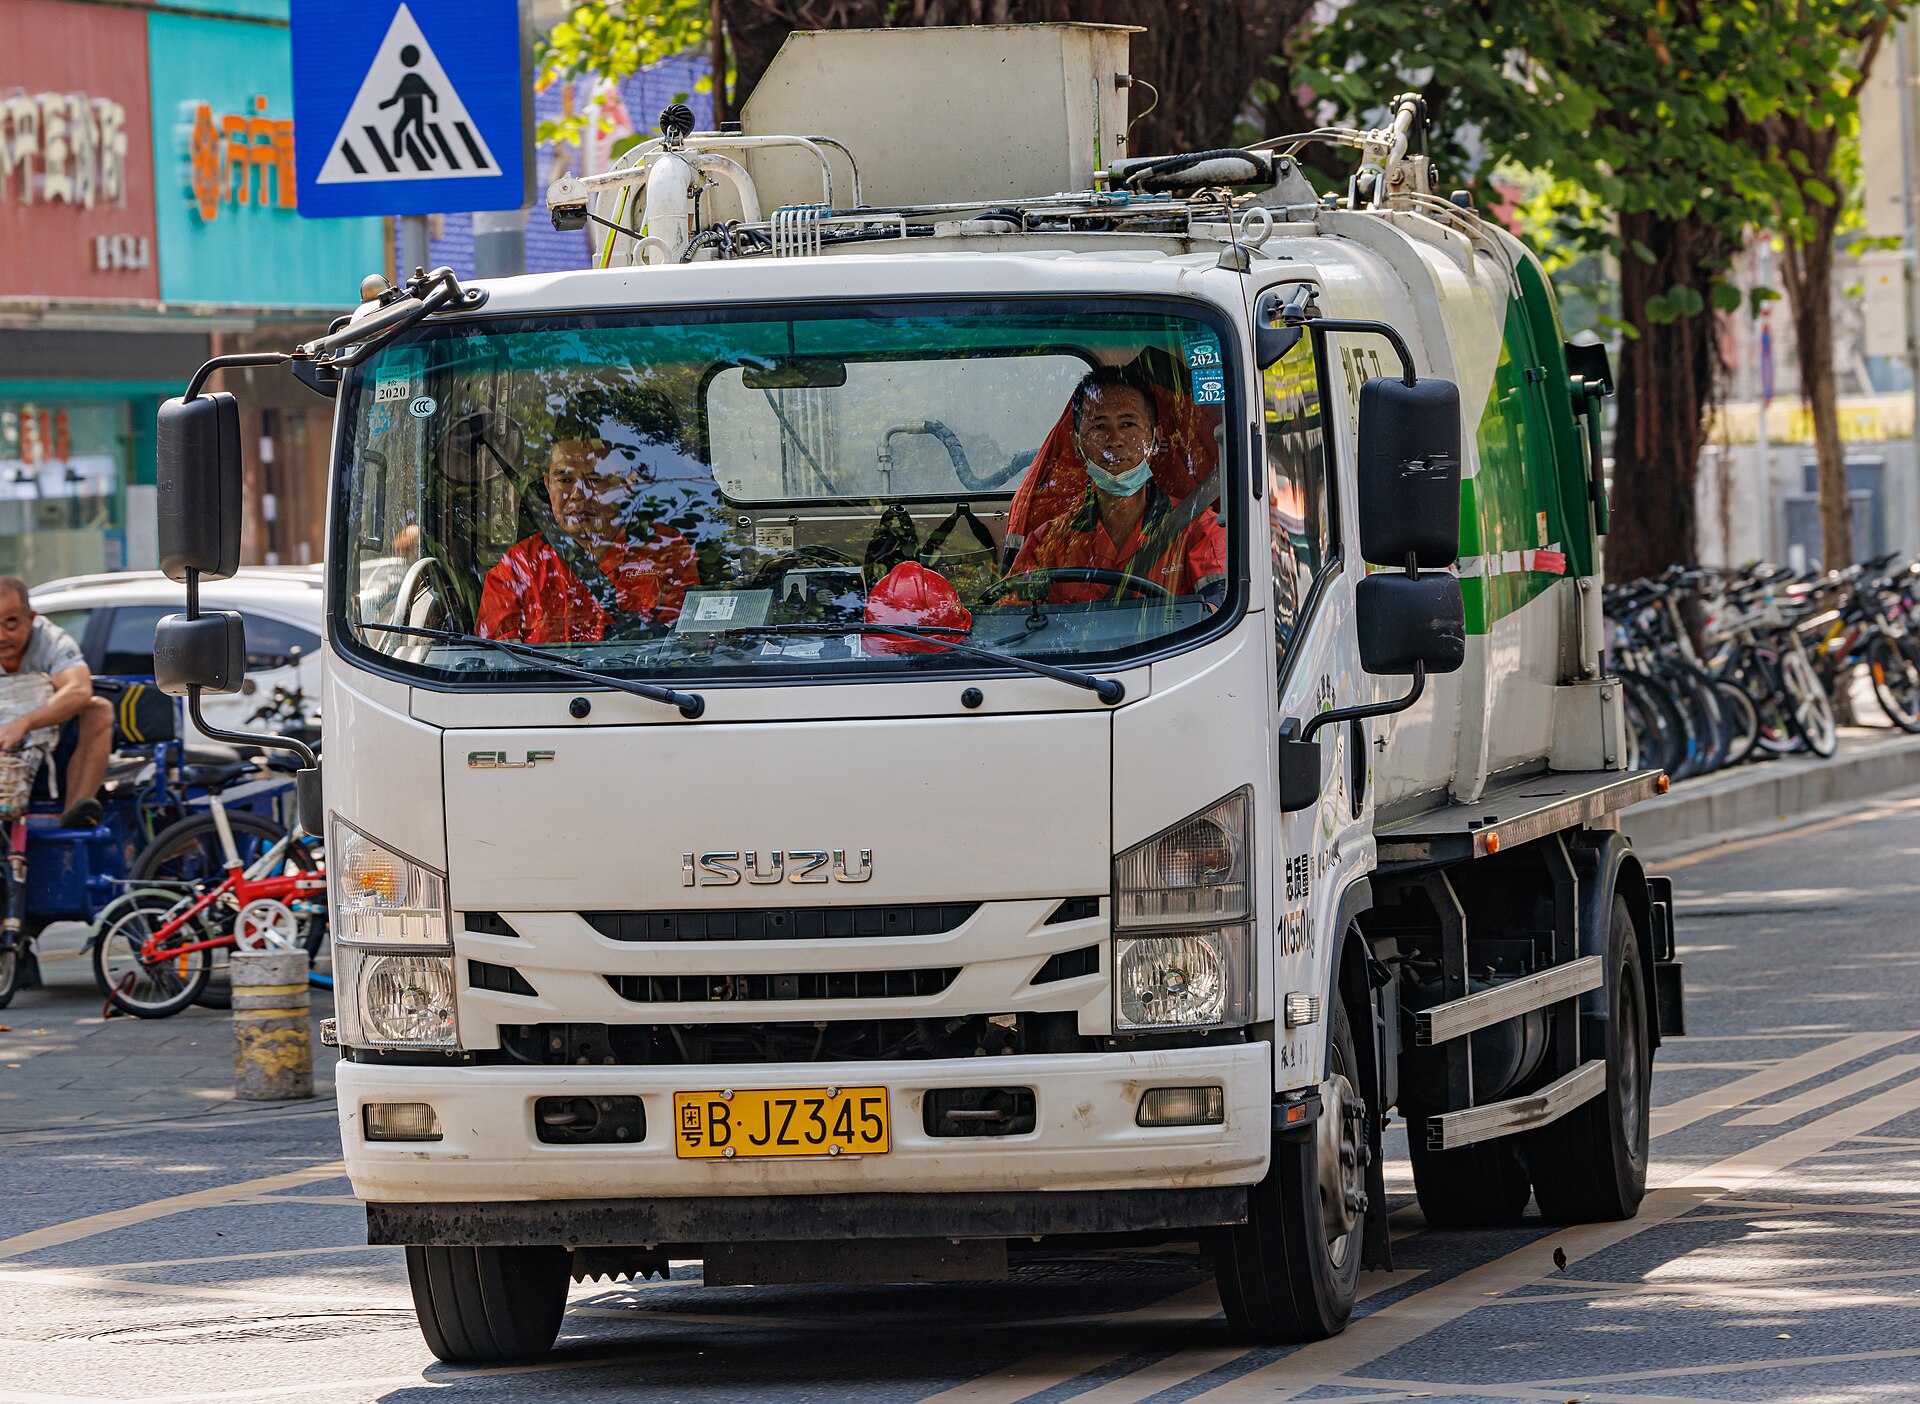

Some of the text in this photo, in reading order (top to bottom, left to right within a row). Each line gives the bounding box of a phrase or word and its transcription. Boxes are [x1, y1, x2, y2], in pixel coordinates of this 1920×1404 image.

[1190, 352, 1220, 367] 2021
[379, 387, 406, 400] 2020
[414, 400, 429, 413] CCC
[467, 751, 555, 769] ELF
[682, 849, 872, 887] ISUZU
[1285, 853, 1309, 901] 总质量
[1277, 907, 1315, 959] 10550kg
[680, 1098, 884, 1148] 粤B·JZ345
